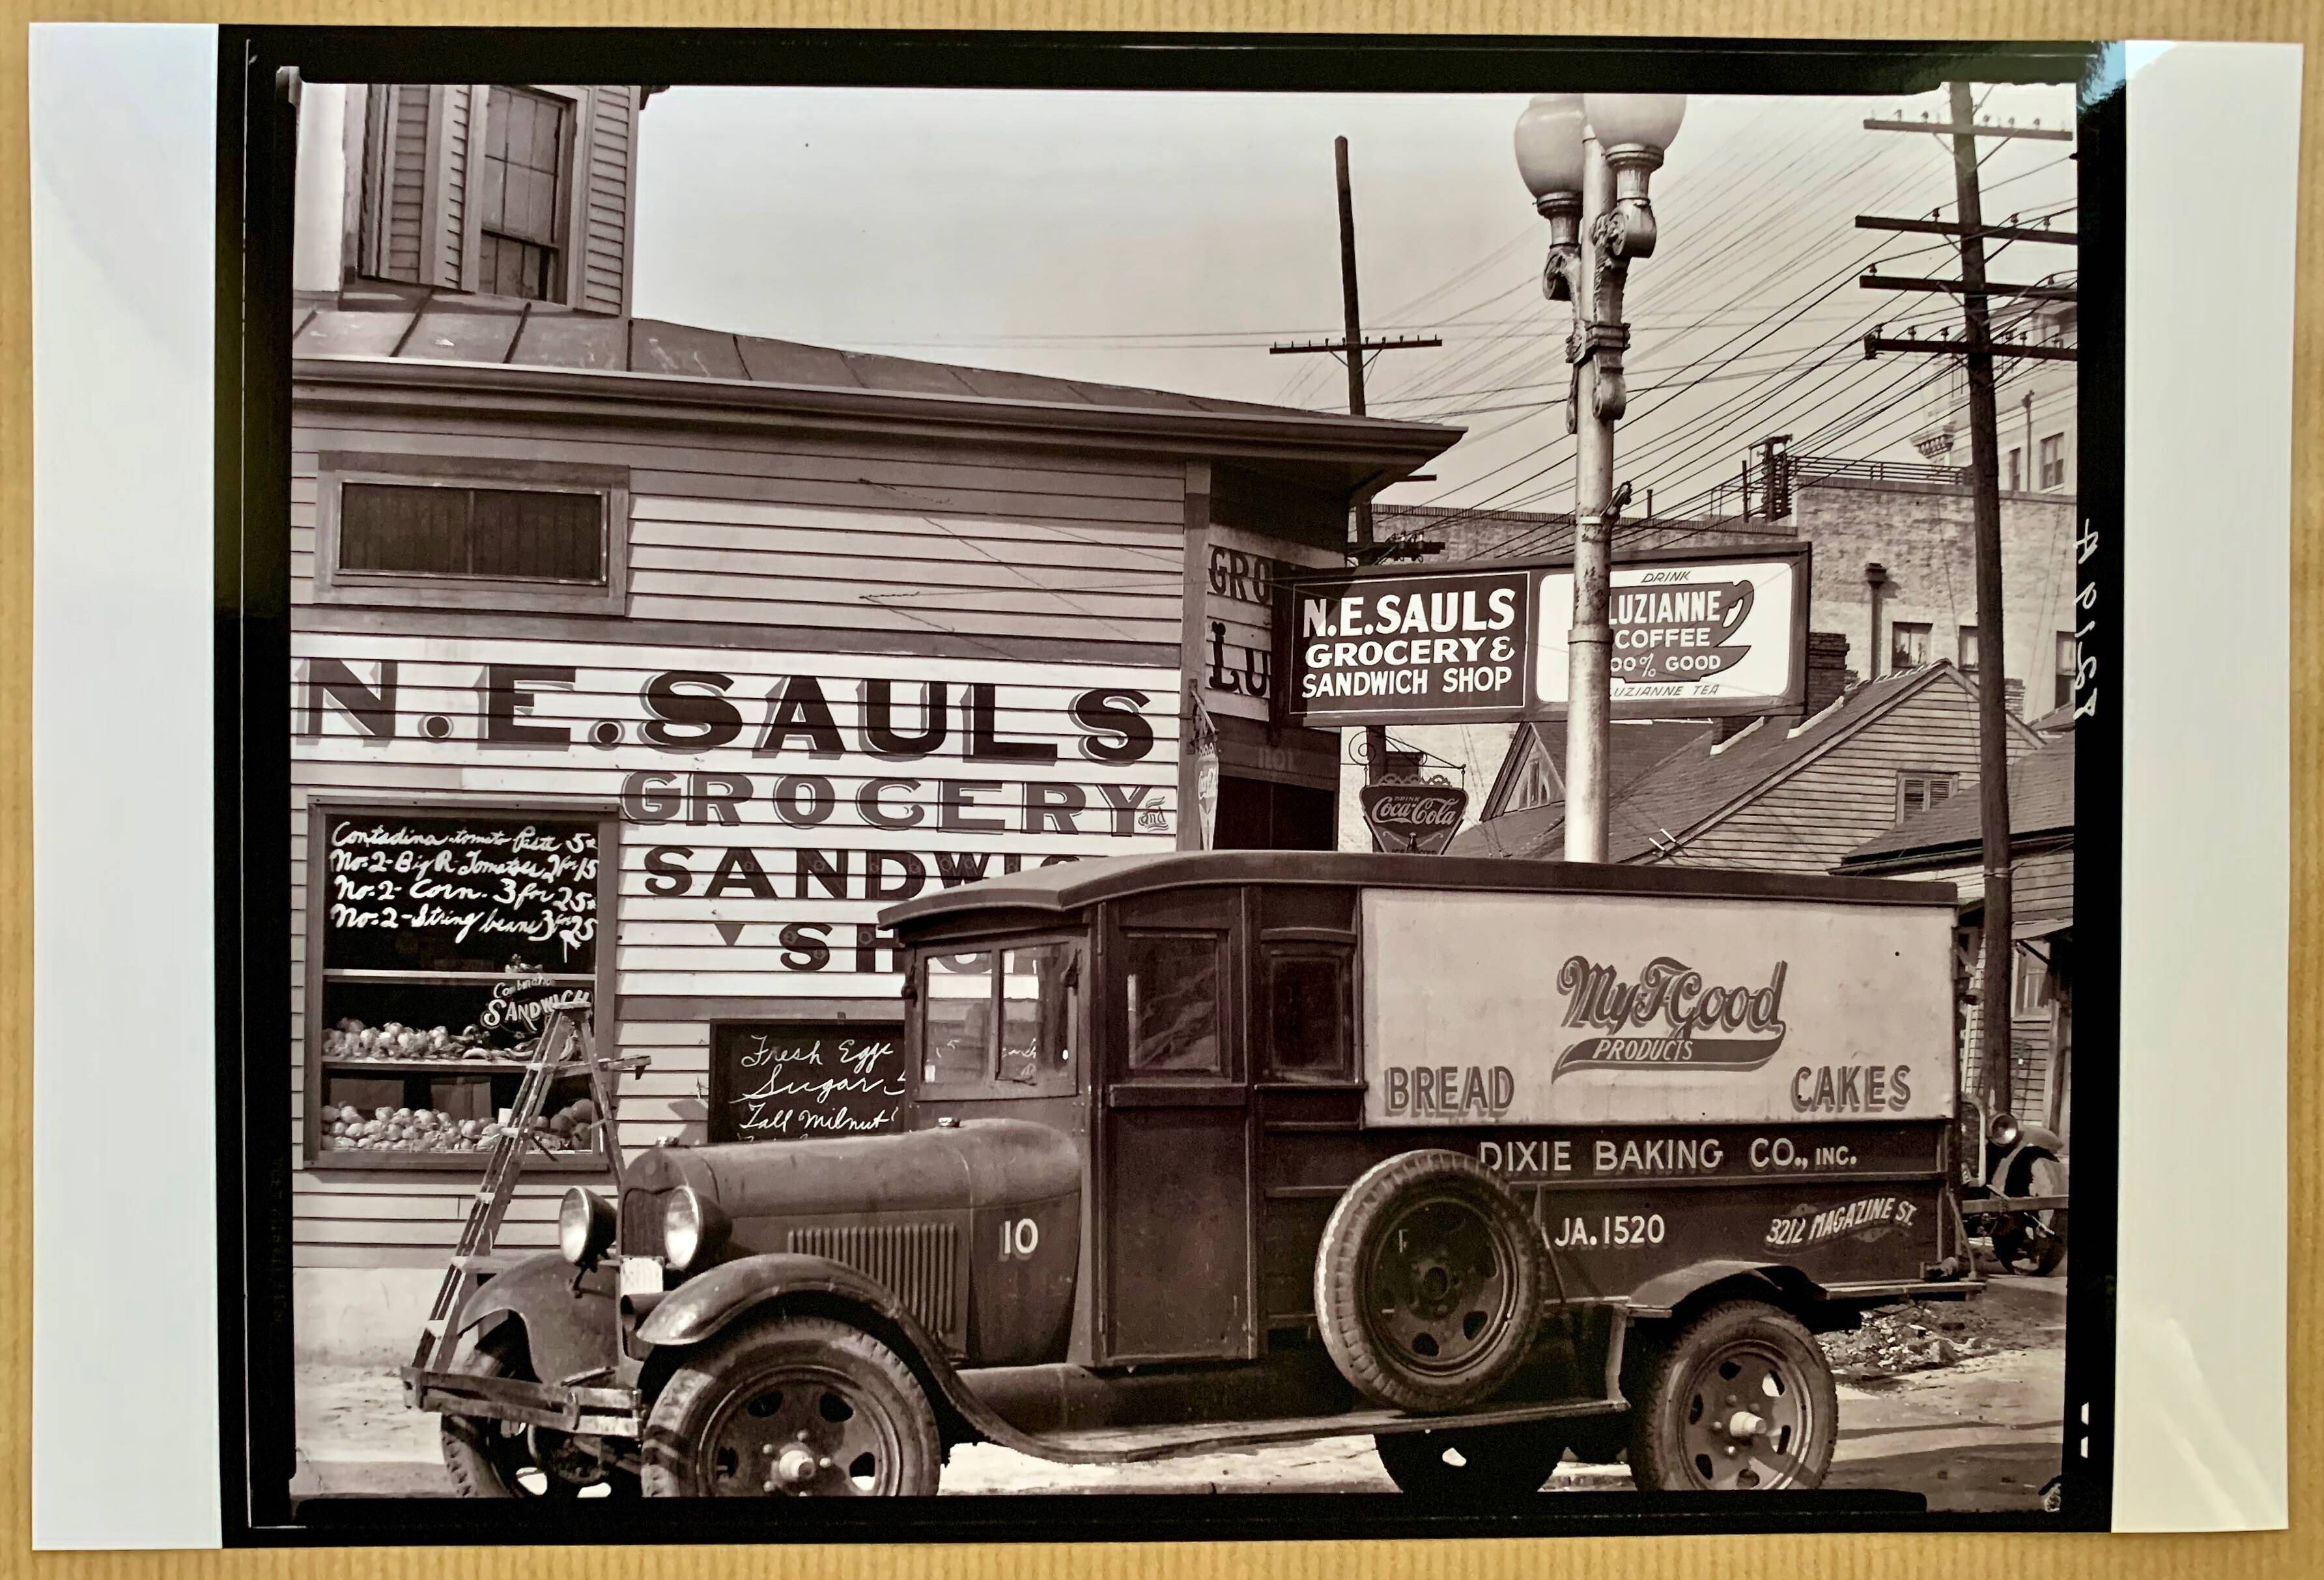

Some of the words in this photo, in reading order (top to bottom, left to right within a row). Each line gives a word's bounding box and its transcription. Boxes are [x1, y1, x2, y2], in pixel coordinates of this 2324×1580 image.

[1641, 571, 1691, 584] DRINK
[1305, 637, 1487, 669] GROCERY
[1615, 627, 1711, 649] COFFEE
[1611, 653, 1656, 678] 00%
[1665, 655, 1721, 671] GOOD
[1302, 669, 1428, 699] SANDWICH
[1442, 666, 1512, 694] SHOP
[1611, 686, 1684, 698] UZIANNE
[1693, 684, 1720, 696] TEA
[621, 771, 1152, 838] GROCERY
[1138, 806, 1167, 826] and
[1372, 796, 1460, 825] Coca-Cola
[644, 846, 1080, 901] SANDW
[493, 878, 517, 904] 3
[514, 882, 556, 910] for
[741, 1035, 823, 1067] Fresh
[1592, 1039, 1693, 1062] PRODUCTS
[728, 1064, 885, 1105] Sugar
[1384, 1066, 1515, 1118] BREAD
[1791, 1065, 1912, 1113] CAKES
[1479, 1140, 1572, 1172] DIXIE
[1595, 1138, 1724, 1171] BAKING
[1817, 1146, 1858, 1165] INC.
[1004, 1218, 1039, 1254] 10
[1766, 1217, 1806, 1245] 3212
[1808, 1198, 1896, 1240] MAGAZINE
[1895, 1201, 1918, 1226] ST.
